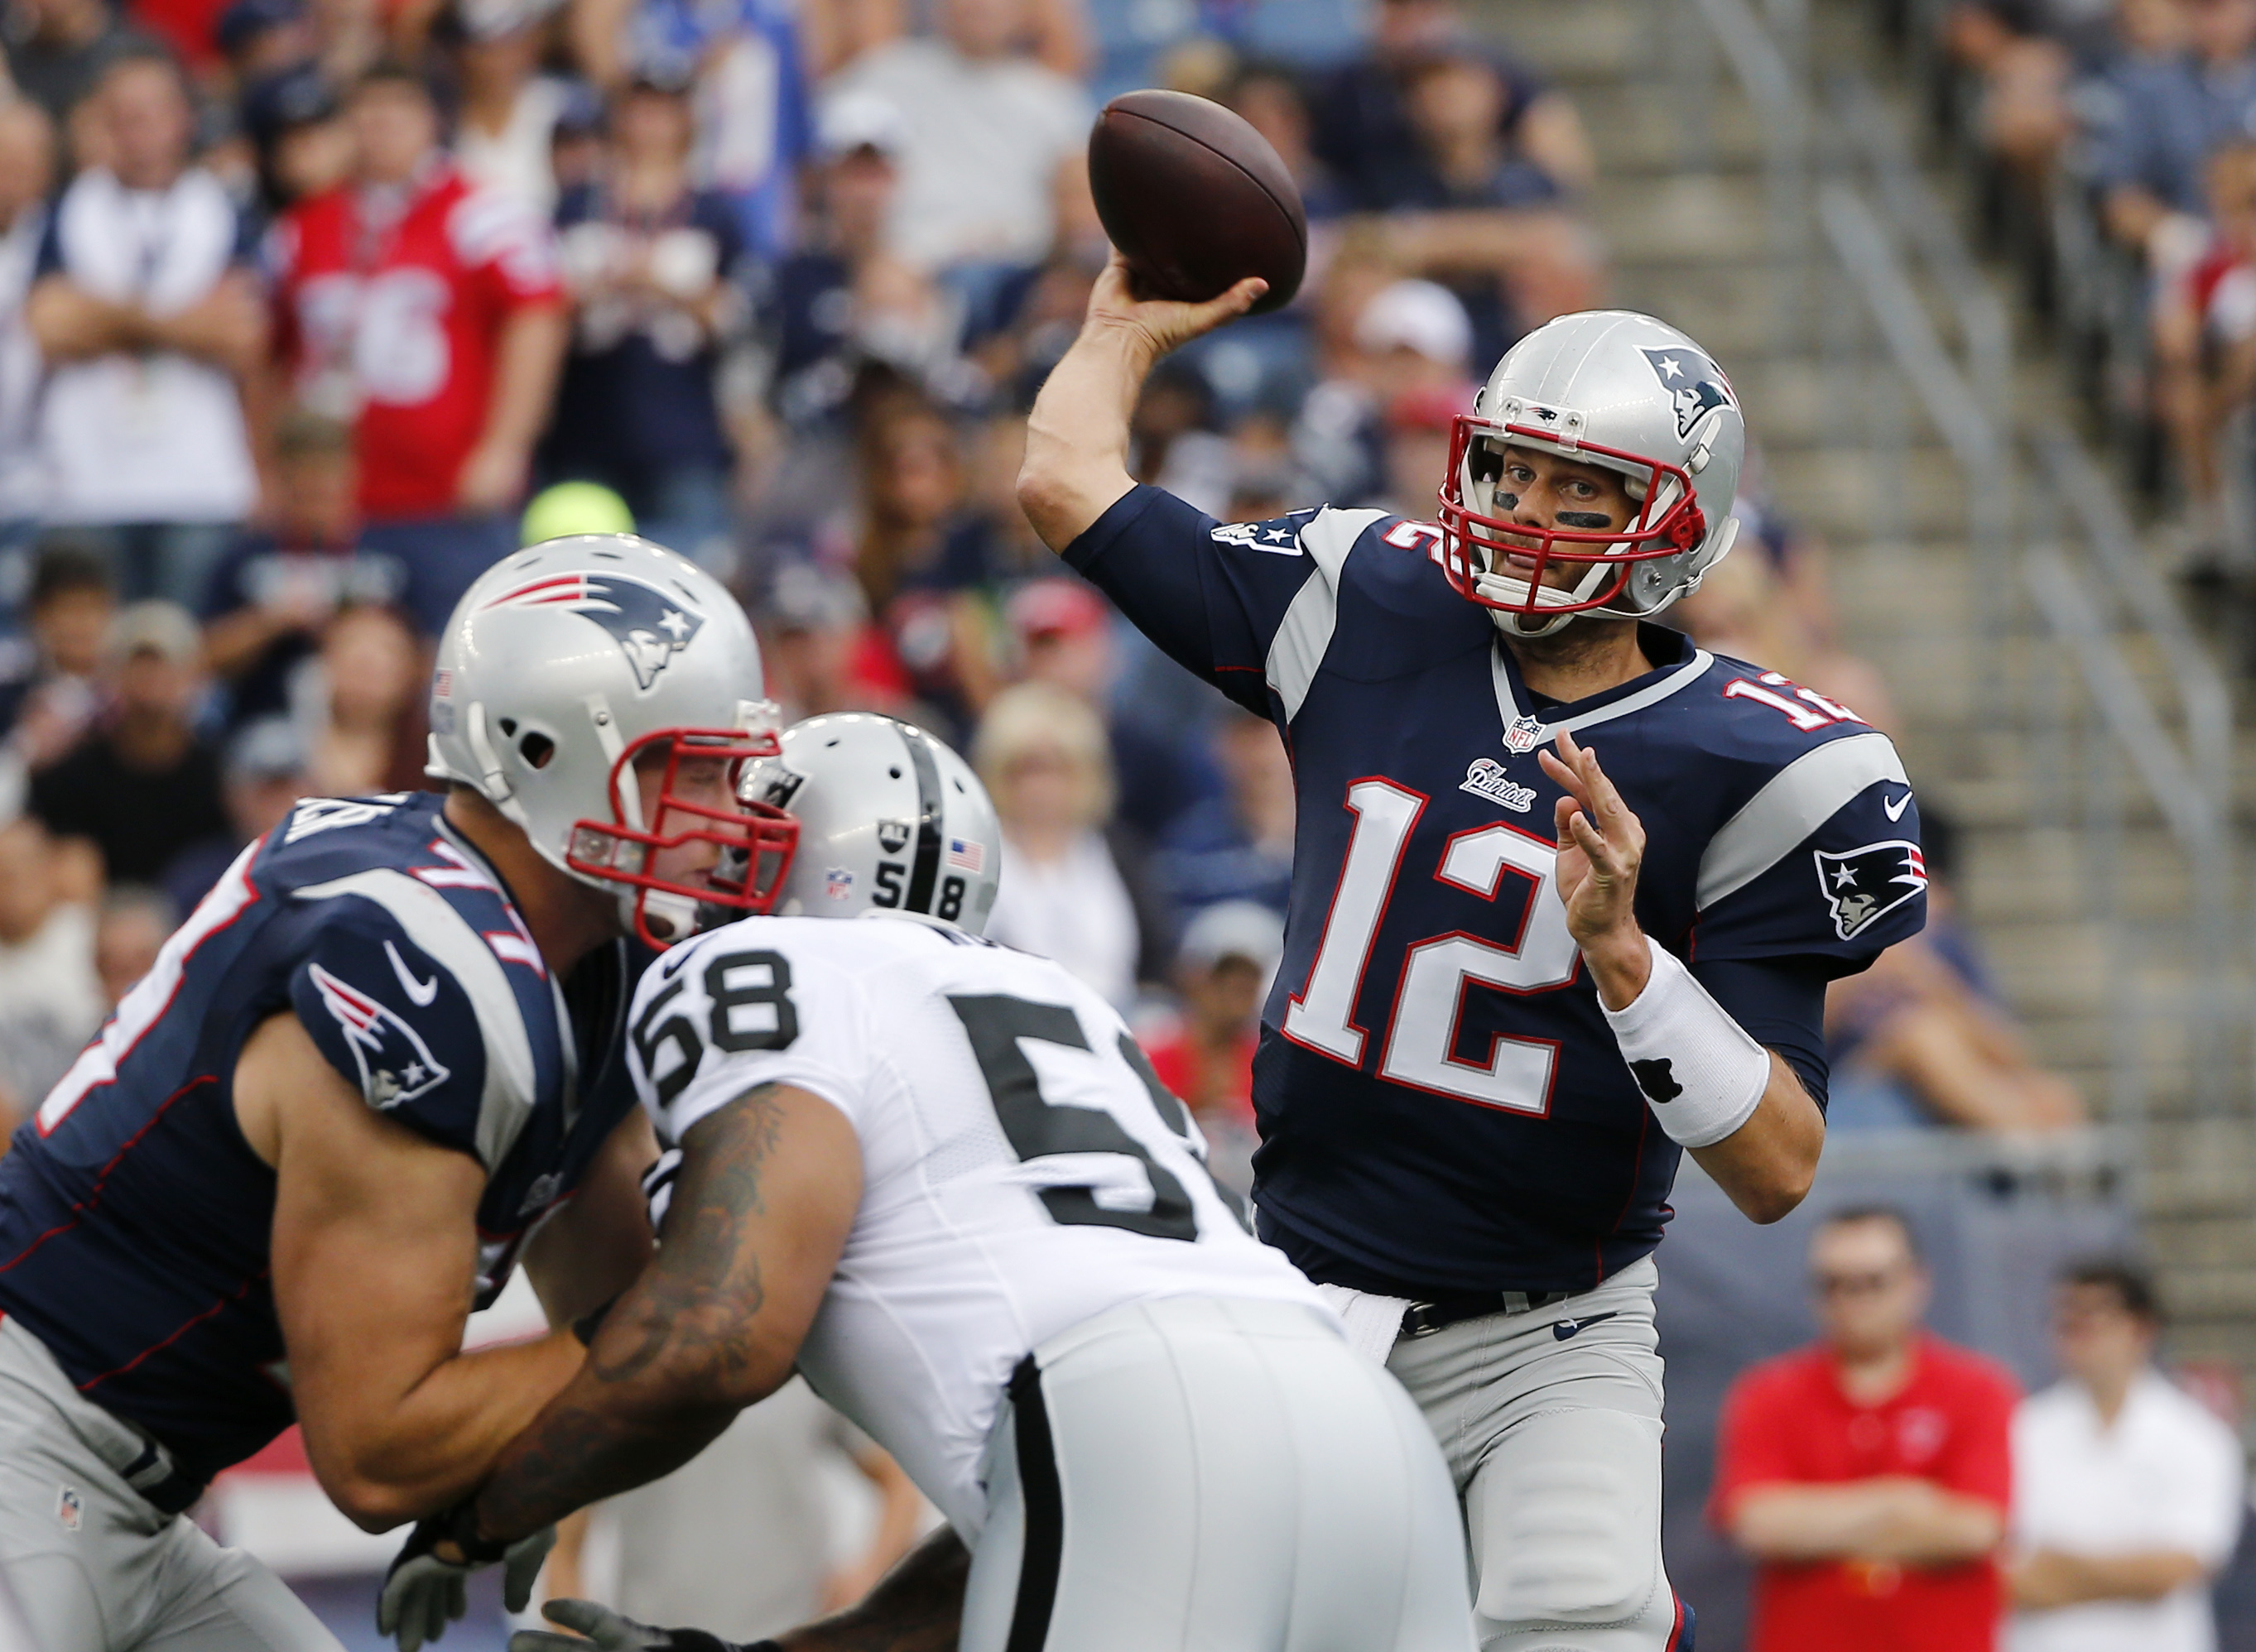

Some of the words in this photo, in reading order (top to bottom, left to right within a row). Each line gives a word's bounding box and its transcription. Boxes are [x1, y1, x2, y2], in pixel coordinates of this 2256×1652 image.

[1722, 670, 1874, 733] 12
[1507, 728, 1533, 748] NFL
[1464, 768, 1537, 808] Patriots
[1280, 774, 1584, 1120] 12
[633, 949, 799, 1107] 58
